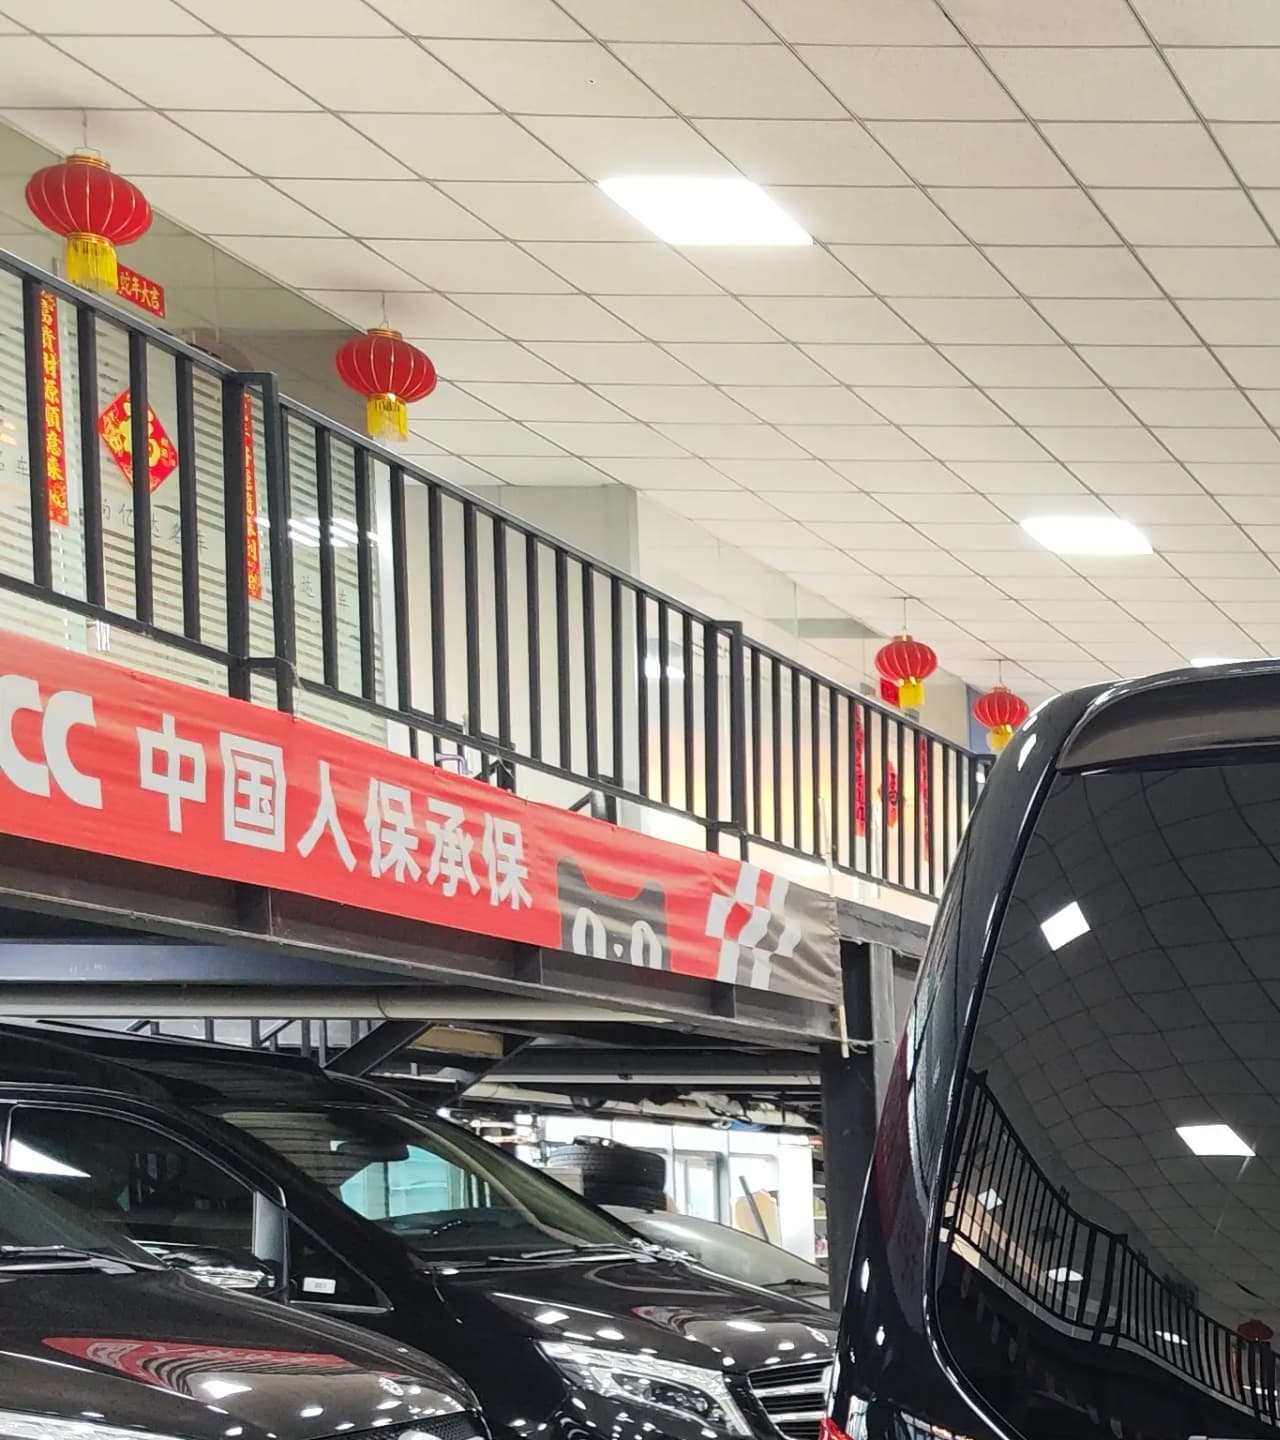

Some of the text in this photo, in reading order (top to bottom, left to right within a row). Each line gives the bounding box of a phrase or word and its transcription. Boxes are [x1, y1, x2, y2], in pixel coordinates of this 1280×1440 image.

[119, 271, 160, 311] 蛇年大吉
[136, 713, 533, 910] 中国人保承保
